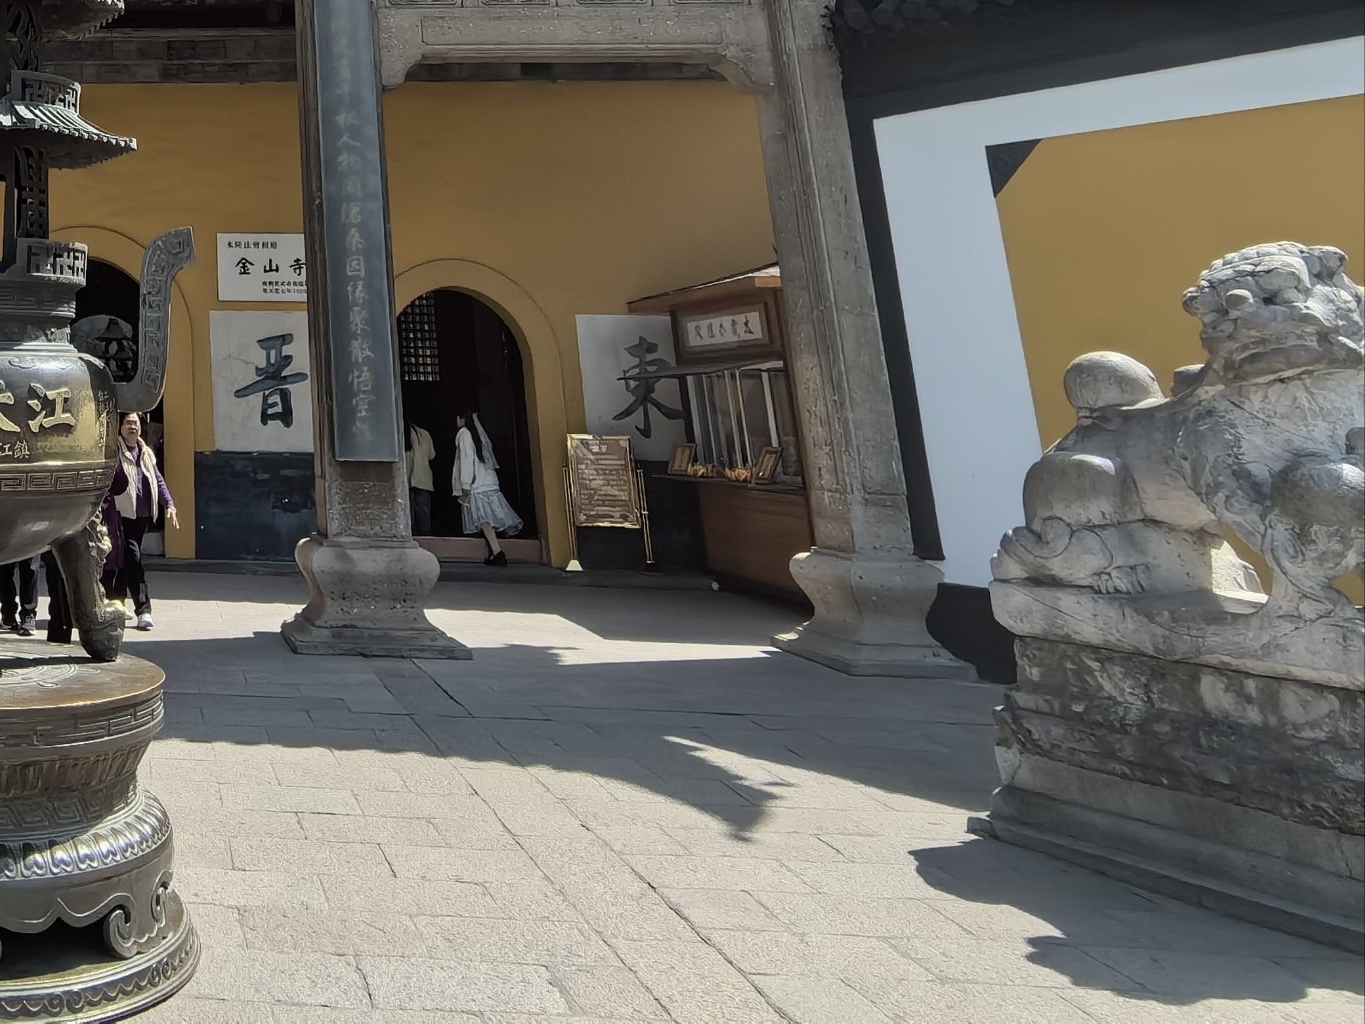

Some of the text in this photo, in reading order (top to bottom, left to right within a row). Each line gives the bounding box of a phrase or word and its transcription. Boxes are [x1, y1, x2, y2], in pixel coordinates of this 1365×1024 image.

[234, 257, 307, 277] 金山寺
[234, 333, 309, 429] 晋
